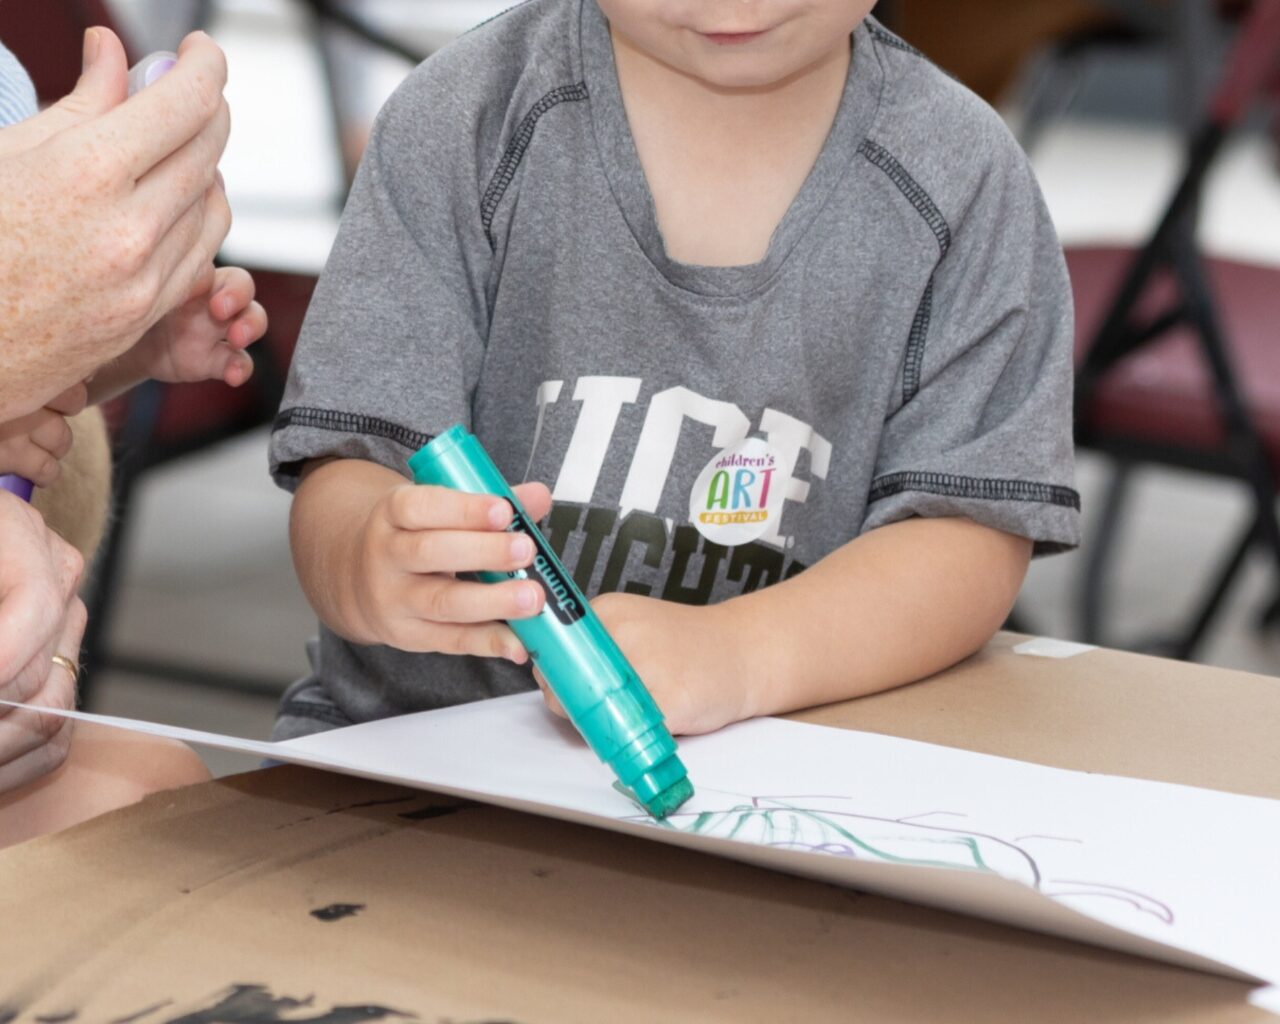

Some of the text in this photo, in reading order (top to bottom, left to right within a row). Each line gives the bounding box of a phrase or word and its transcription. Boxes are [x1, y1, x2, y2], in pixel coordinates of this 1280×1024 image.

[715, 453, 774, 468] children's
[706, 467, 776, 510] ART
[704, 512, 764, 524] FESTIVAL
[533, 554, 576, 611] Jumb
